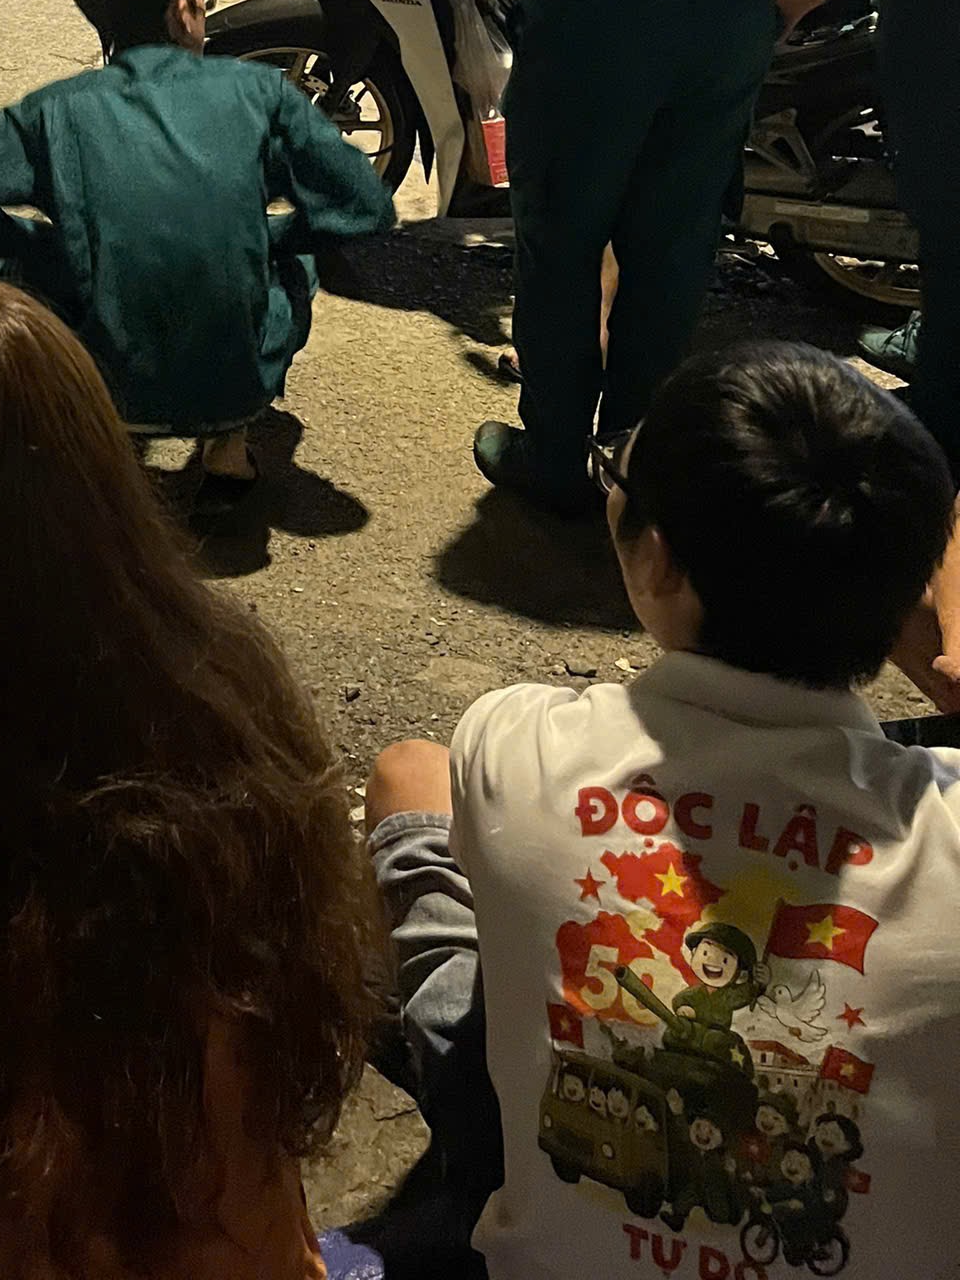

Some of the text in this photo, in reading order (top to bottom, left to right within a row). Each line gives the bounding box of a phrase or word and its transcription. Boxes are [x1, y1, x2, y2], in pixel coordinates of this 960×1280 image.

[575, 774, 874, 875] ĐỘC LẬP
[622, 1223, 688, 1279] TỰ
